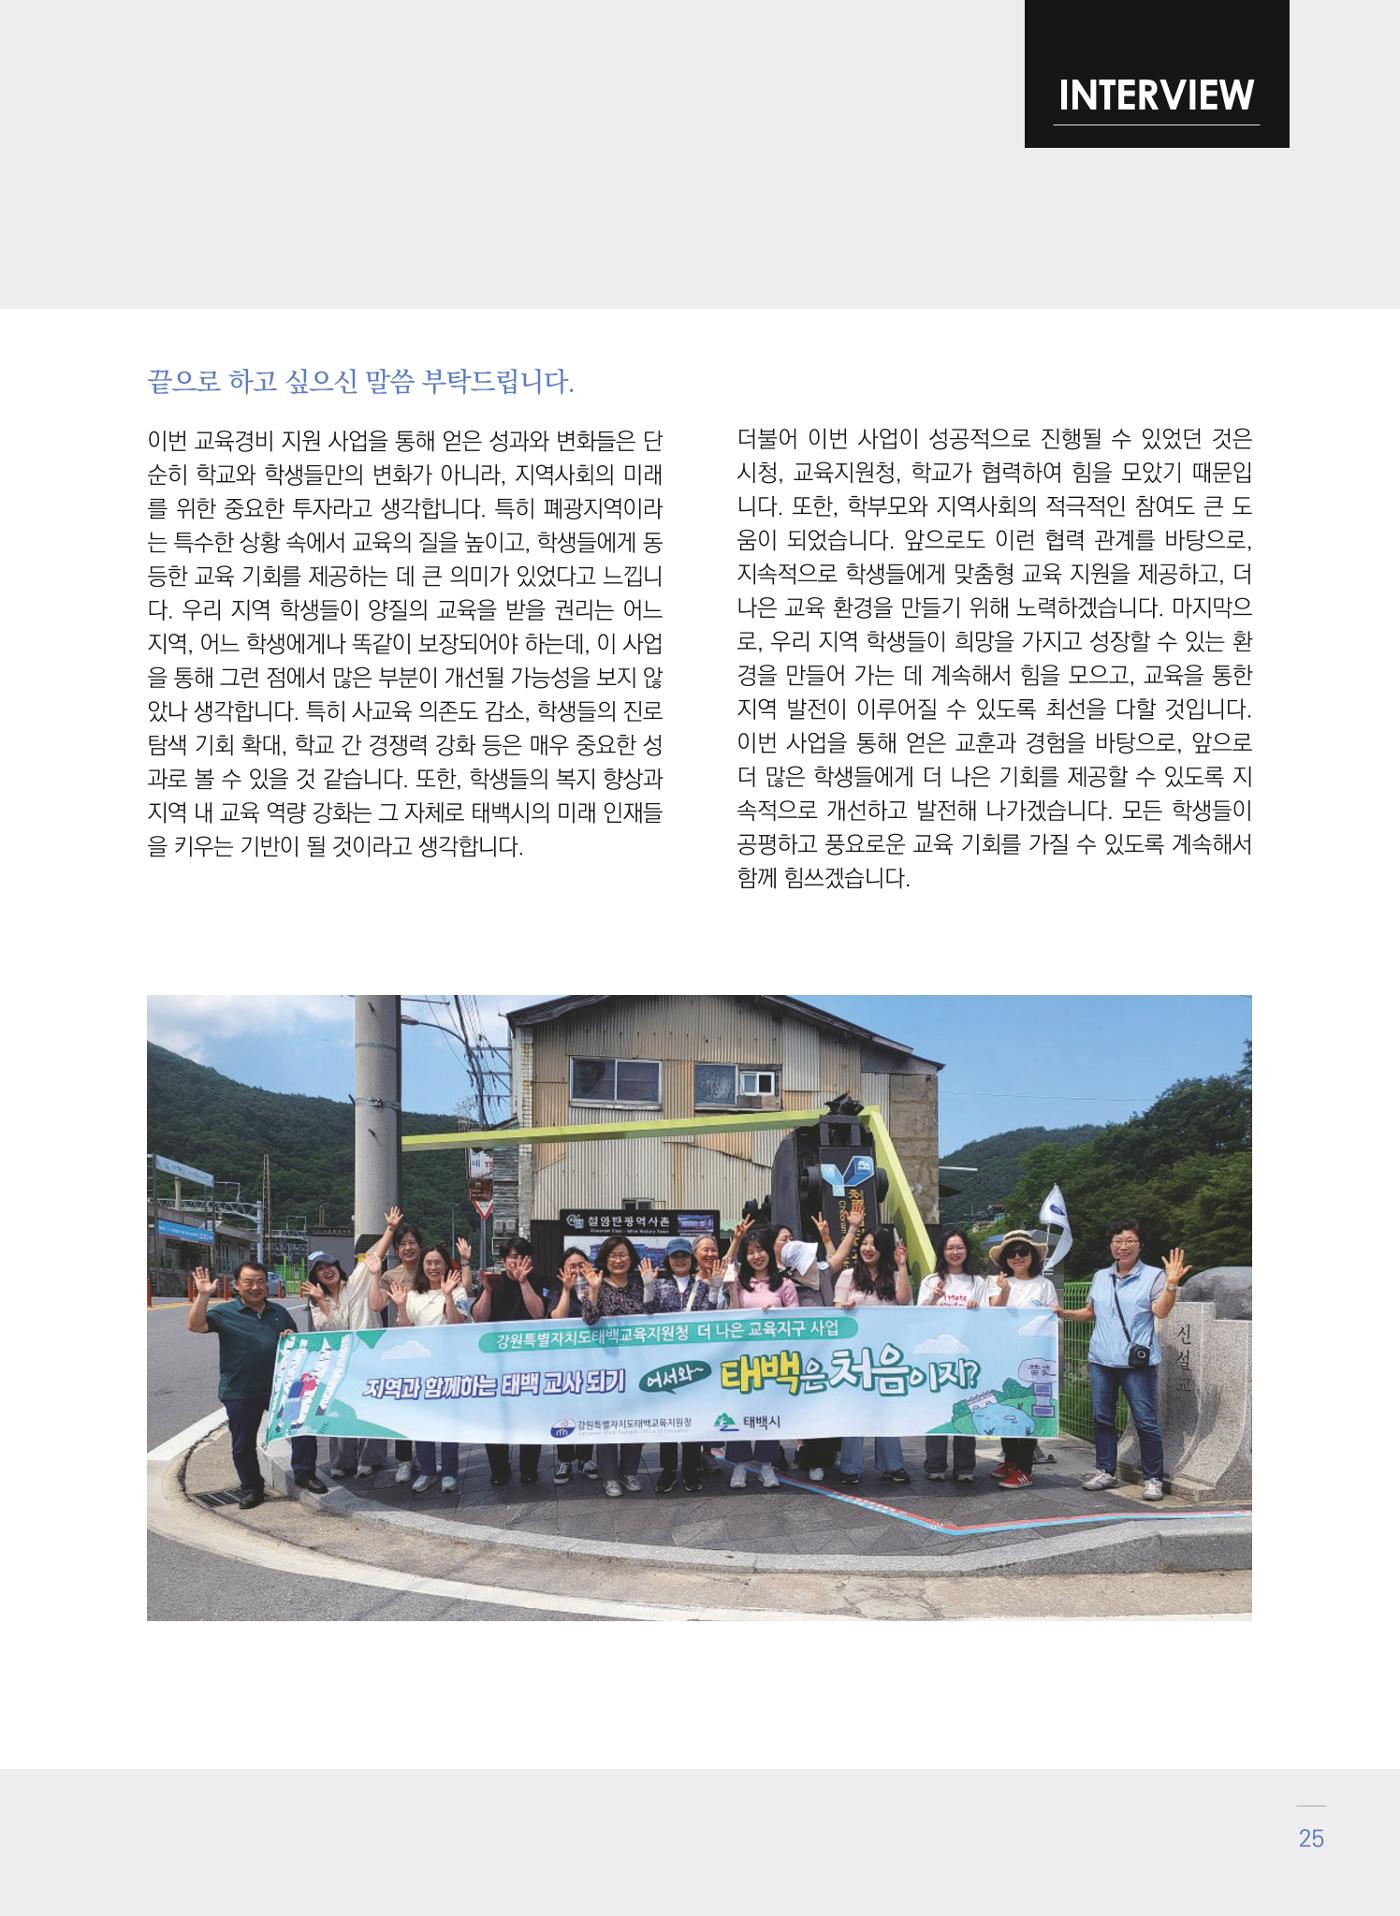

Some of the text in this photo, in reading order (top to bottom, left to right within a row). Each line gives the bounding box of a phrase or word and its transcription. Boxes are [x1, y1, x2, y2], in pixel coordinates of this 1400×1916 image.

[1060, 78, 1255, 111] INTERVIEW
[147, 367, 574, 396] 끝으로 하고 싶으신 말씀 부탁드립니다.
[148, 429, 664, 453] 이번 교육경비 지원 사업을 통해 얻은 성과와 변화들은 단
[738, 427, 1253, 451] 더불어 이번 사업이 성공적으로 진행될 수 있었던 것은
[147, 497, 664, 521] 를 위한 중요한 투자라고 생각합니다. 특히 폐광지역이라
[738, 495, 1253, 519] 니다. 또한, 학부모와 지역사회의 적극적인 참여도 큰 도
[147, 564, 662, 588] 등한 교육 기회를 제공하는 데 큰 의미가 있었다고 느낍니
[737, 562, 1251, 586] 지속적으로 학생들에게 맞춤형 교육 지원을 제공하고, 더
[147, 632, 662, 656] 지역, 어느 학생에게나 똑같이 보장되어야 하는데, 이 사업
[736, 630, 1254, 654] 로, 우리 지역 학생들이 희망을 가지고 성장할 수 있는 환
[148, 700, 664, 724] 았나 생각합니다. 특히 사교육 의존도 감소, 학생들의 진로
[737, 697, 1252, 721] 지역 발전이 이루어질 수 있도록 최선을 다할 것입니다.
[147, 767, 664, 791] 과로 볼 수 있을 것 같습니다. 또한, 학생들의 복지 향상과
[738, 765, 1252, 789] 더 많은 학생들에게 더 나은 기회를 제공할 수 있도록 지
[147, 835, 523, 859] 을 키우는 기반이 될 것이라고 생각합니다.
[736, 832, 1252, 857] 공평하고 풍요로운 교육 기회를 가질 수 있도록 계속해서
[496, 1319, 840, 1350] 강원특별자치도태백교육지원청 더 나은 교육지구 사업
[363, 1369, 626, 1400] 지역과 함께하는 태백 교사 되기
[743, 1415, 781, 1430] 태백시
[1299, 1828, 1325, 1848] 25
